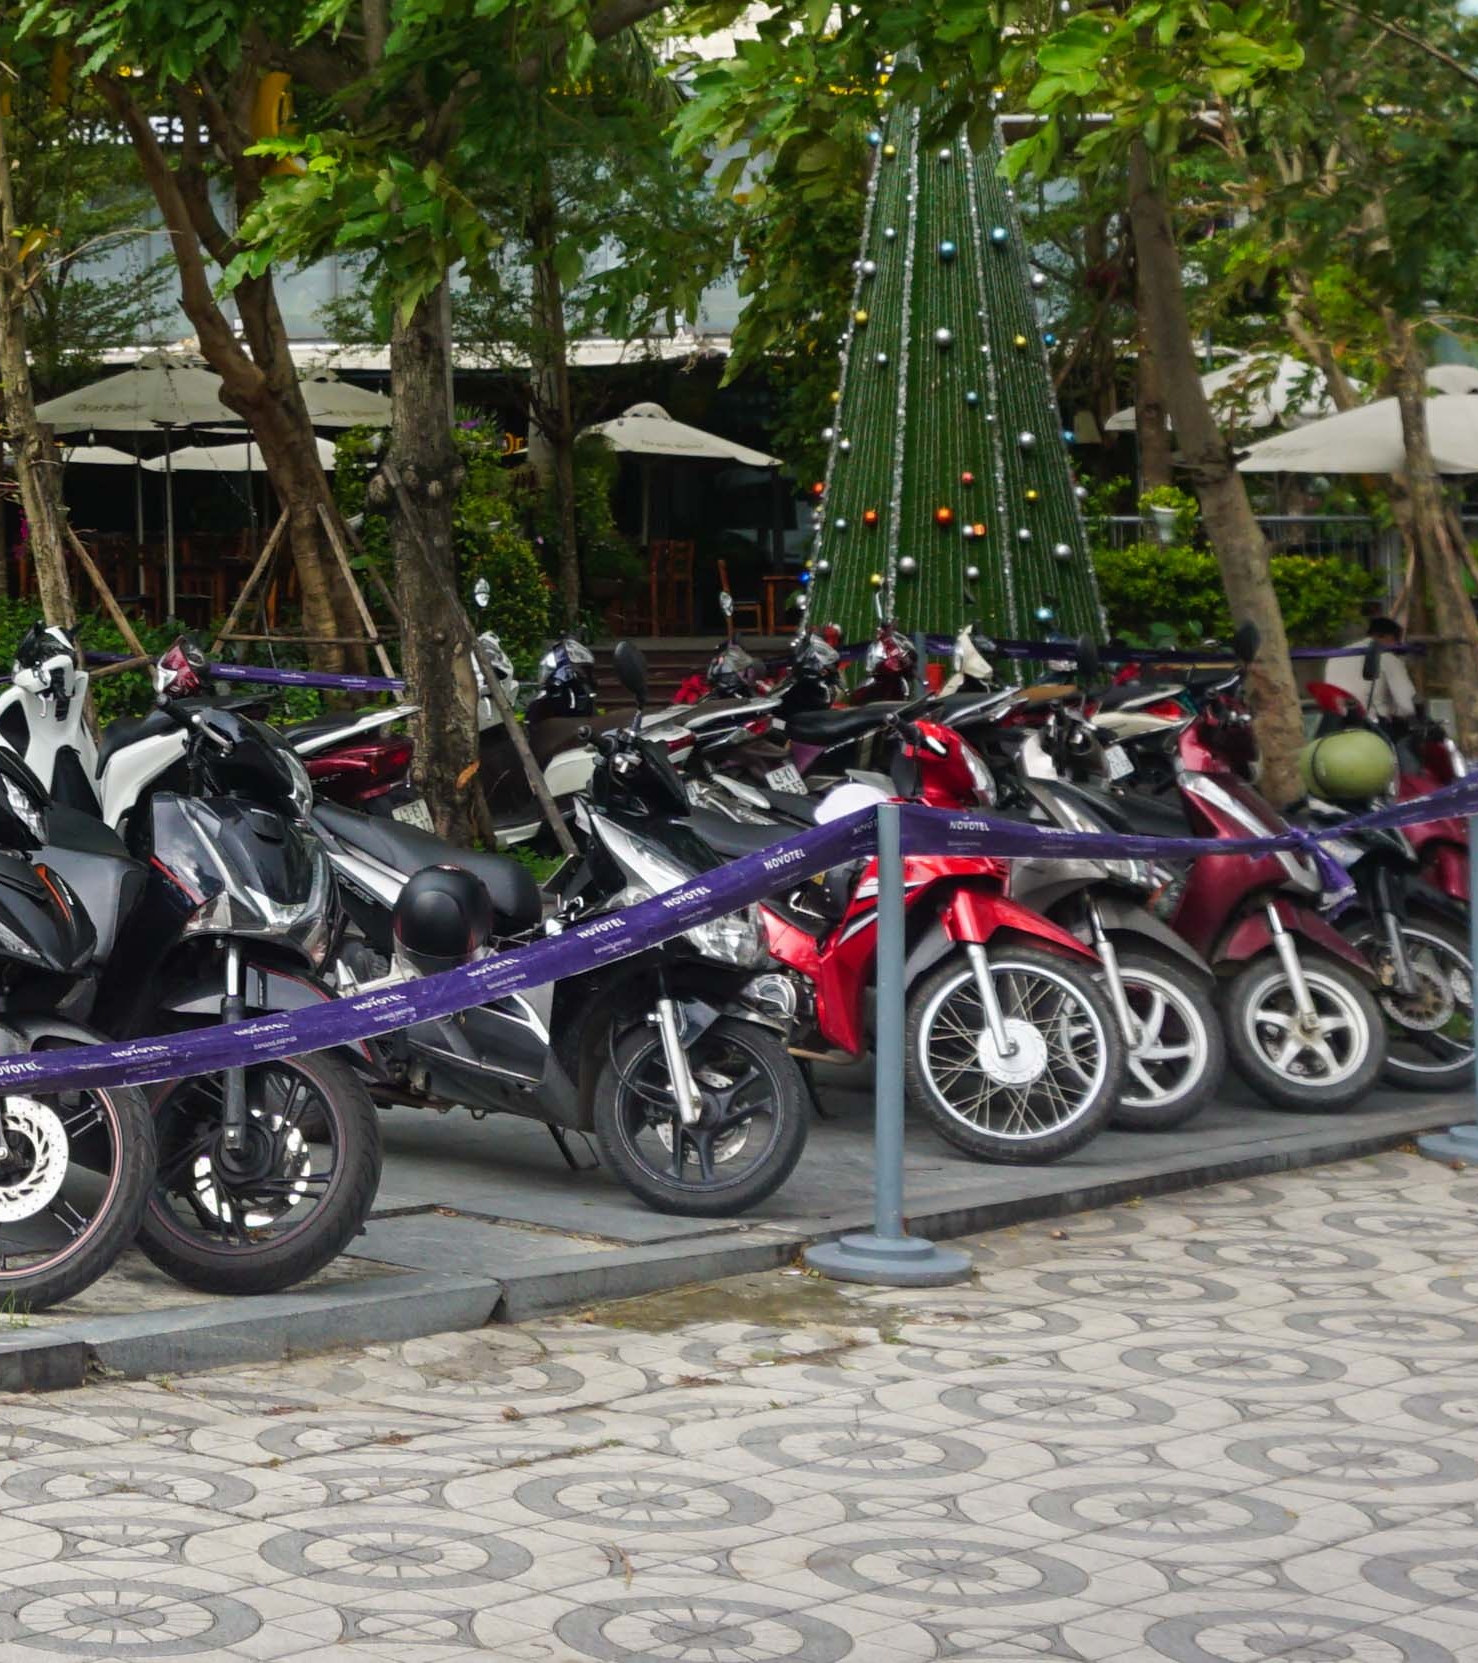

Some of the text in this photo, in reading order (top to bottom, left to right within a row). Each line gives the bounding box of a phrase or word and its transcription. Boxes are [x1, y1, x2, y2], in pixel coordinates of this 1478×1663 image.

[949, 820, 990, 833] NOVOTEL
[763, 847, 806, 871] NOVOTEL
[663, 885, 712, 909] NOVOTEL
[576, 917, 627, 939] NOVOTEL
[352, 993, 407, 1011] NOVOTEL
